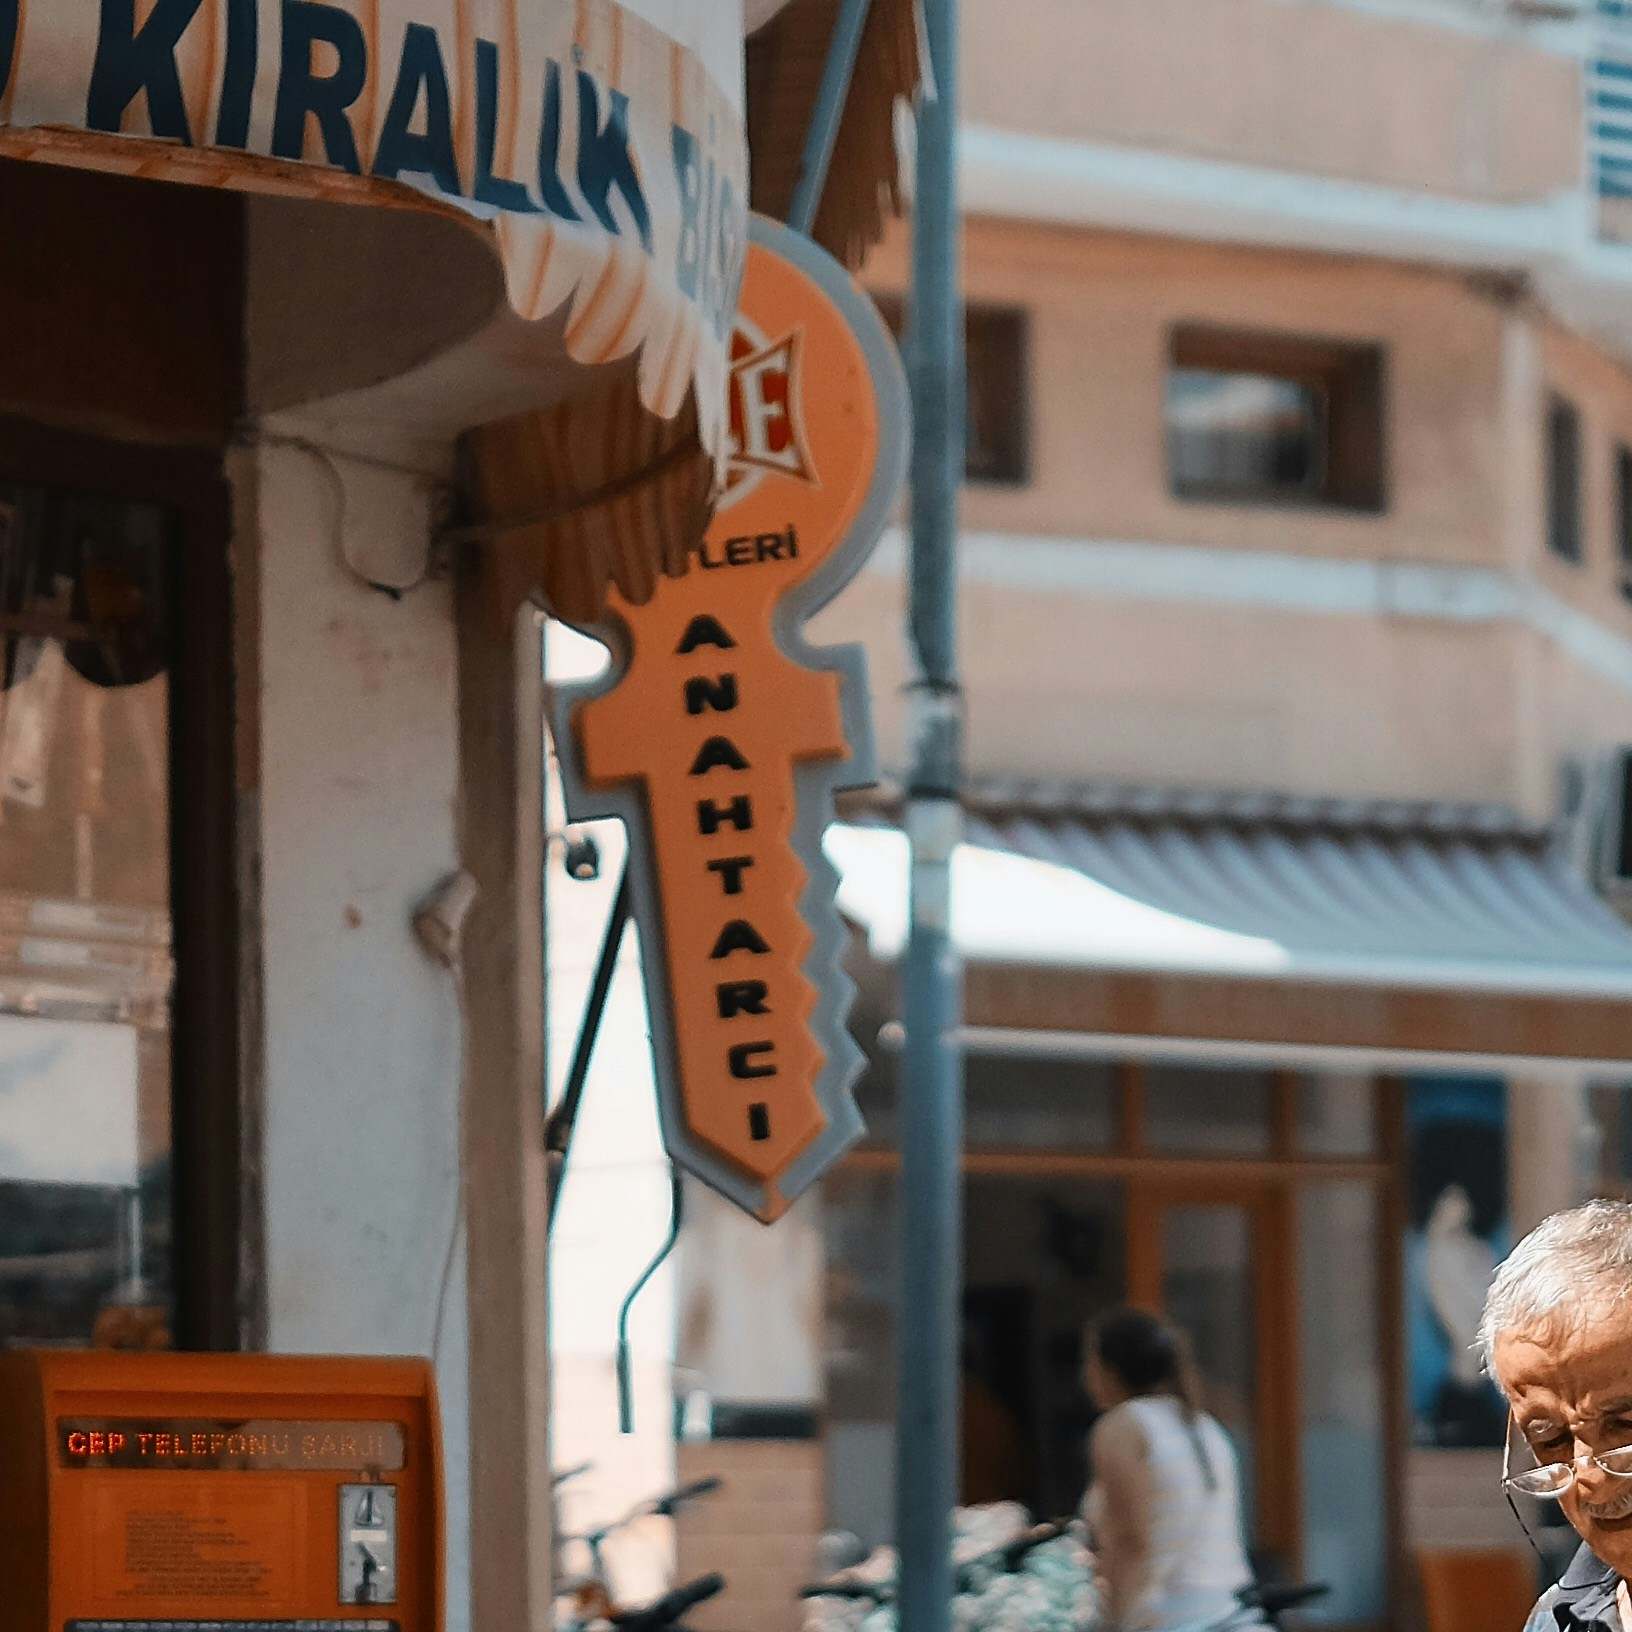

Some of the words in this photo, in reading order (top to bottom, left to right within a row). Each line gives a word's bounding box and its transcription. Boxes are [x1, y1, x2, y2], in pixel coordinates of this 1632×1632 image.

[698, 523, 800, 570] LERİ
[675, 613, 778, 1142] ANAHTARCI
[68, 1432, 126, 1456] CEP
[137, 1433, 289, 1456] TELEFONU
